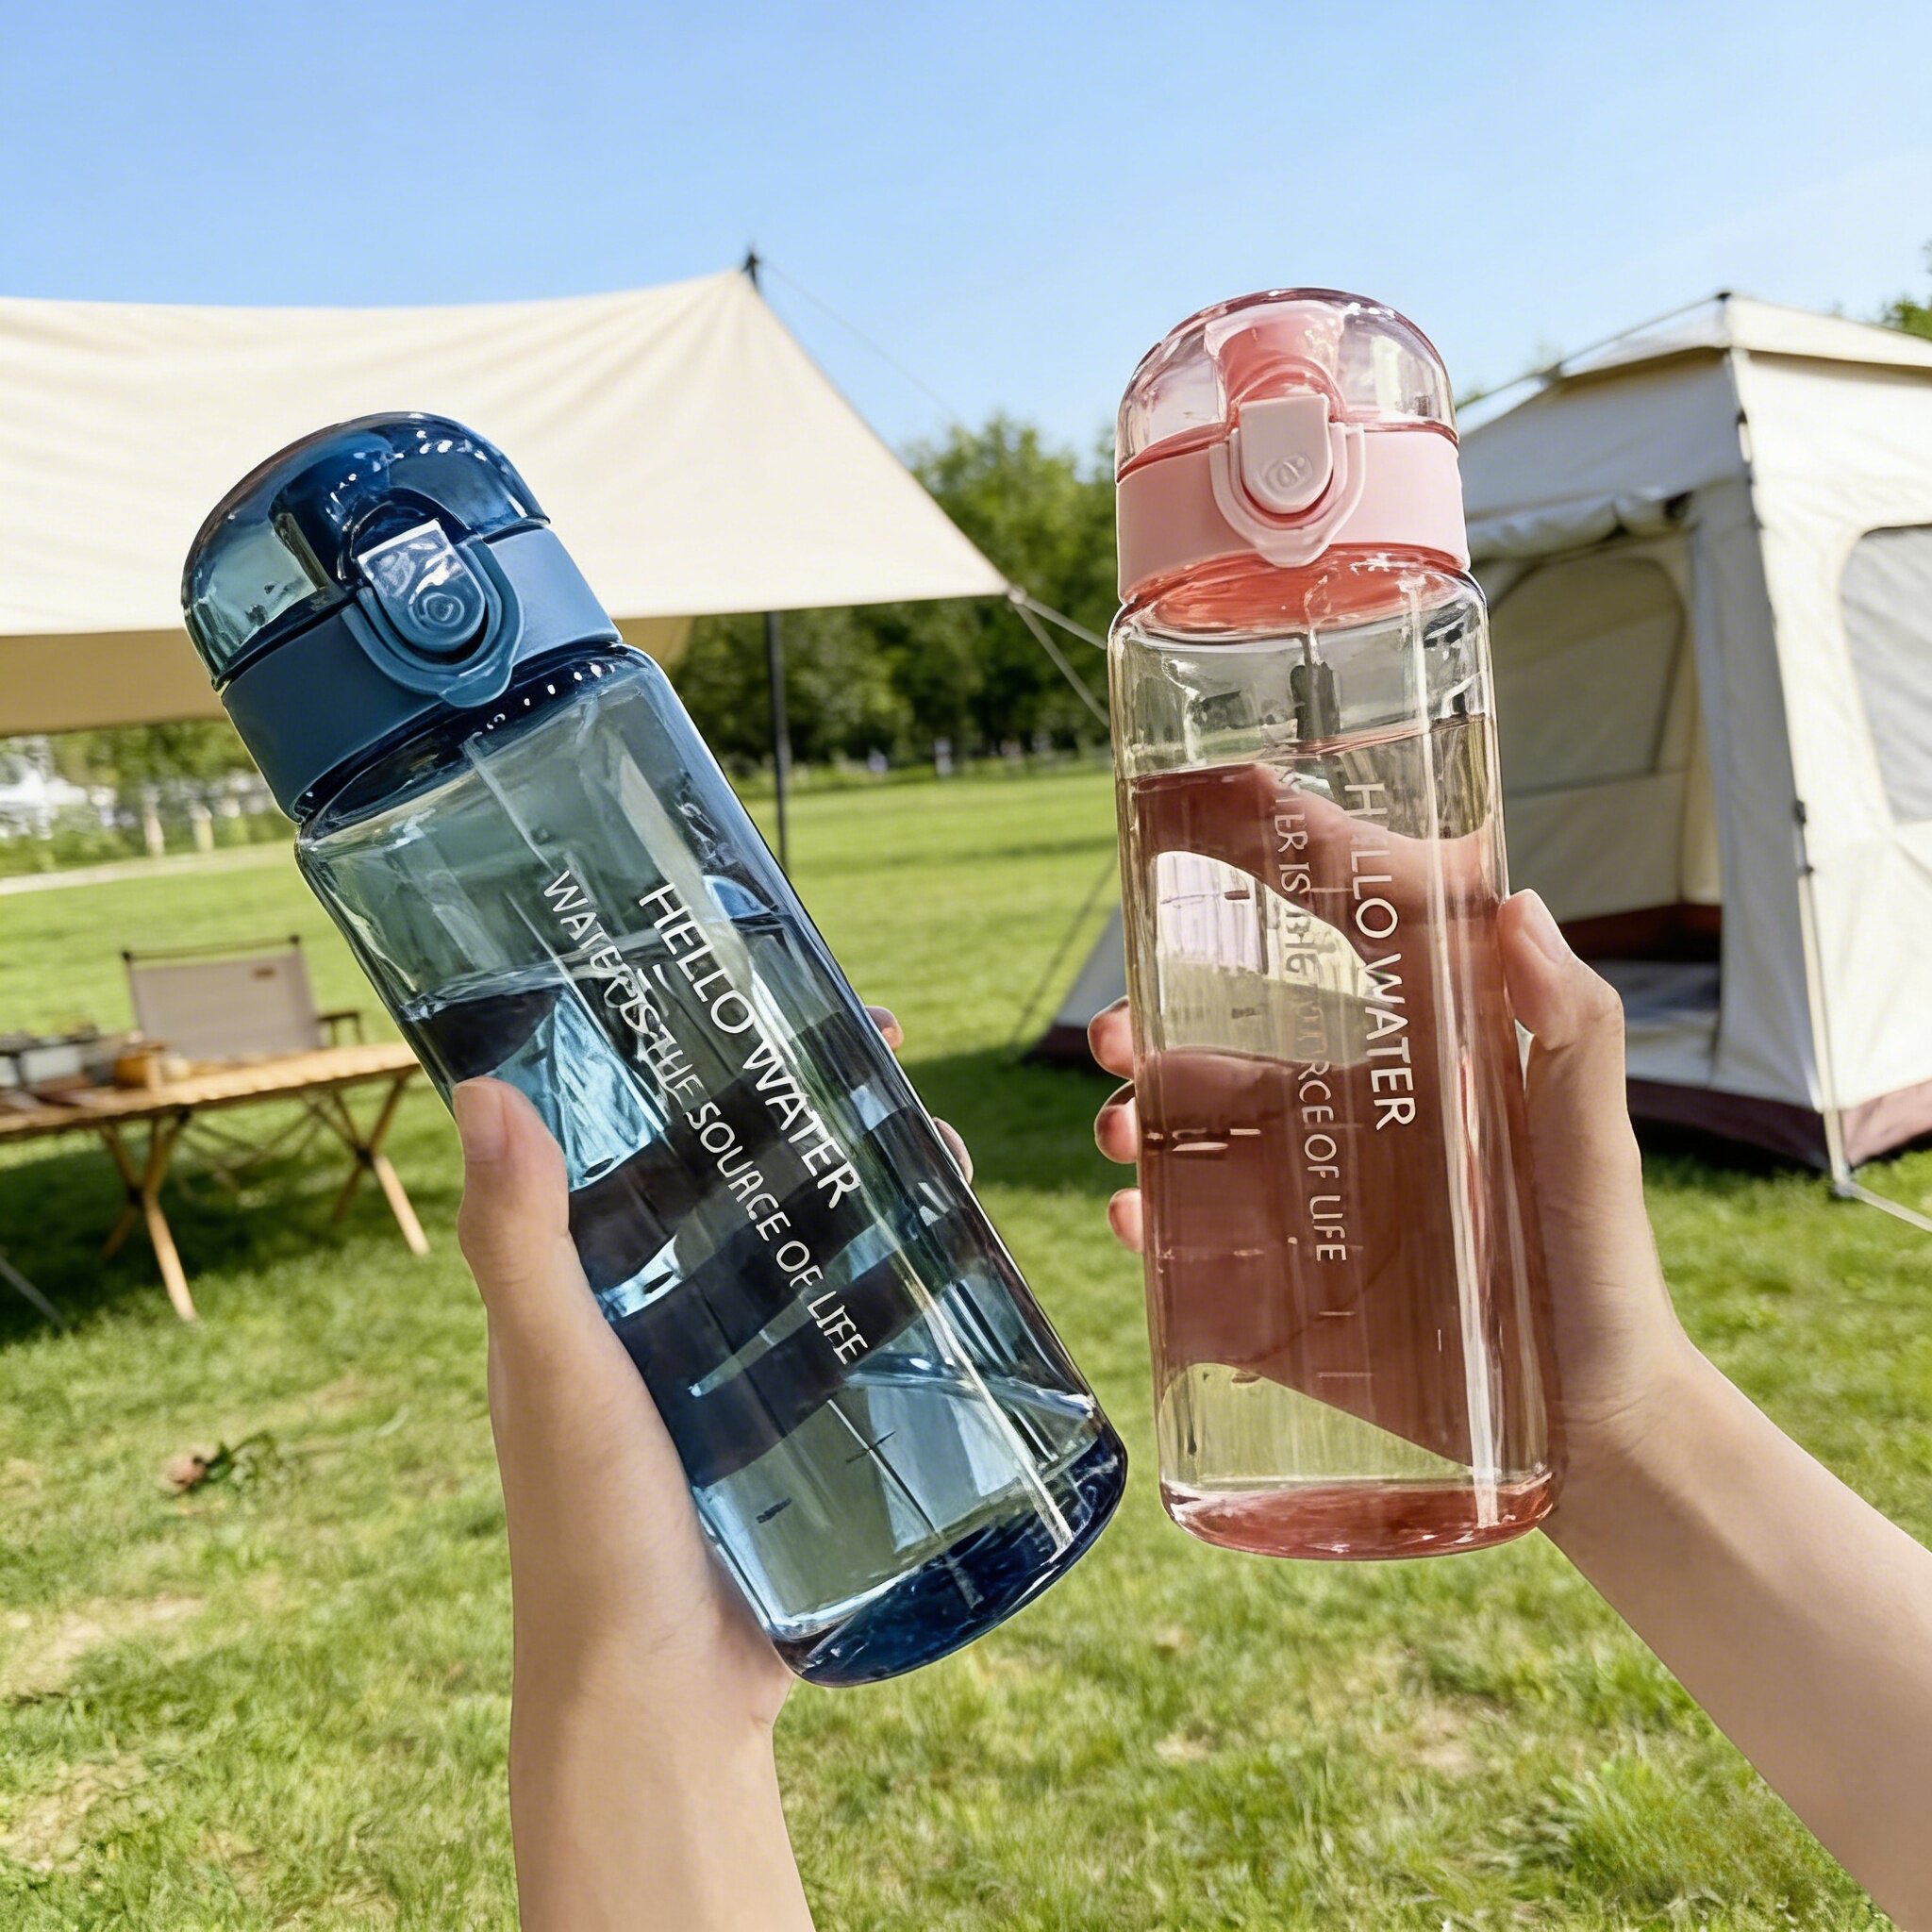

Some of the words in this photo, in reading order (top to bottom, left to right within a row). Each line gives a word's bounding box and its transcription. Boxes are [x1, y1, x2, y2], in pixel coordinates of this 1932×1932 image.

[638, 882, 754, 1034] HELLO
[742, 1040, 860, 1209] WATER
[1278, 861, 1312, 894] IS
[1303, 1133, 1341, 1179] OF
[1365, 952, 1417, 1130] WATER
[775, 1240, 824, 1288] OF
[807, 1290, 869, 1366] LIFE
